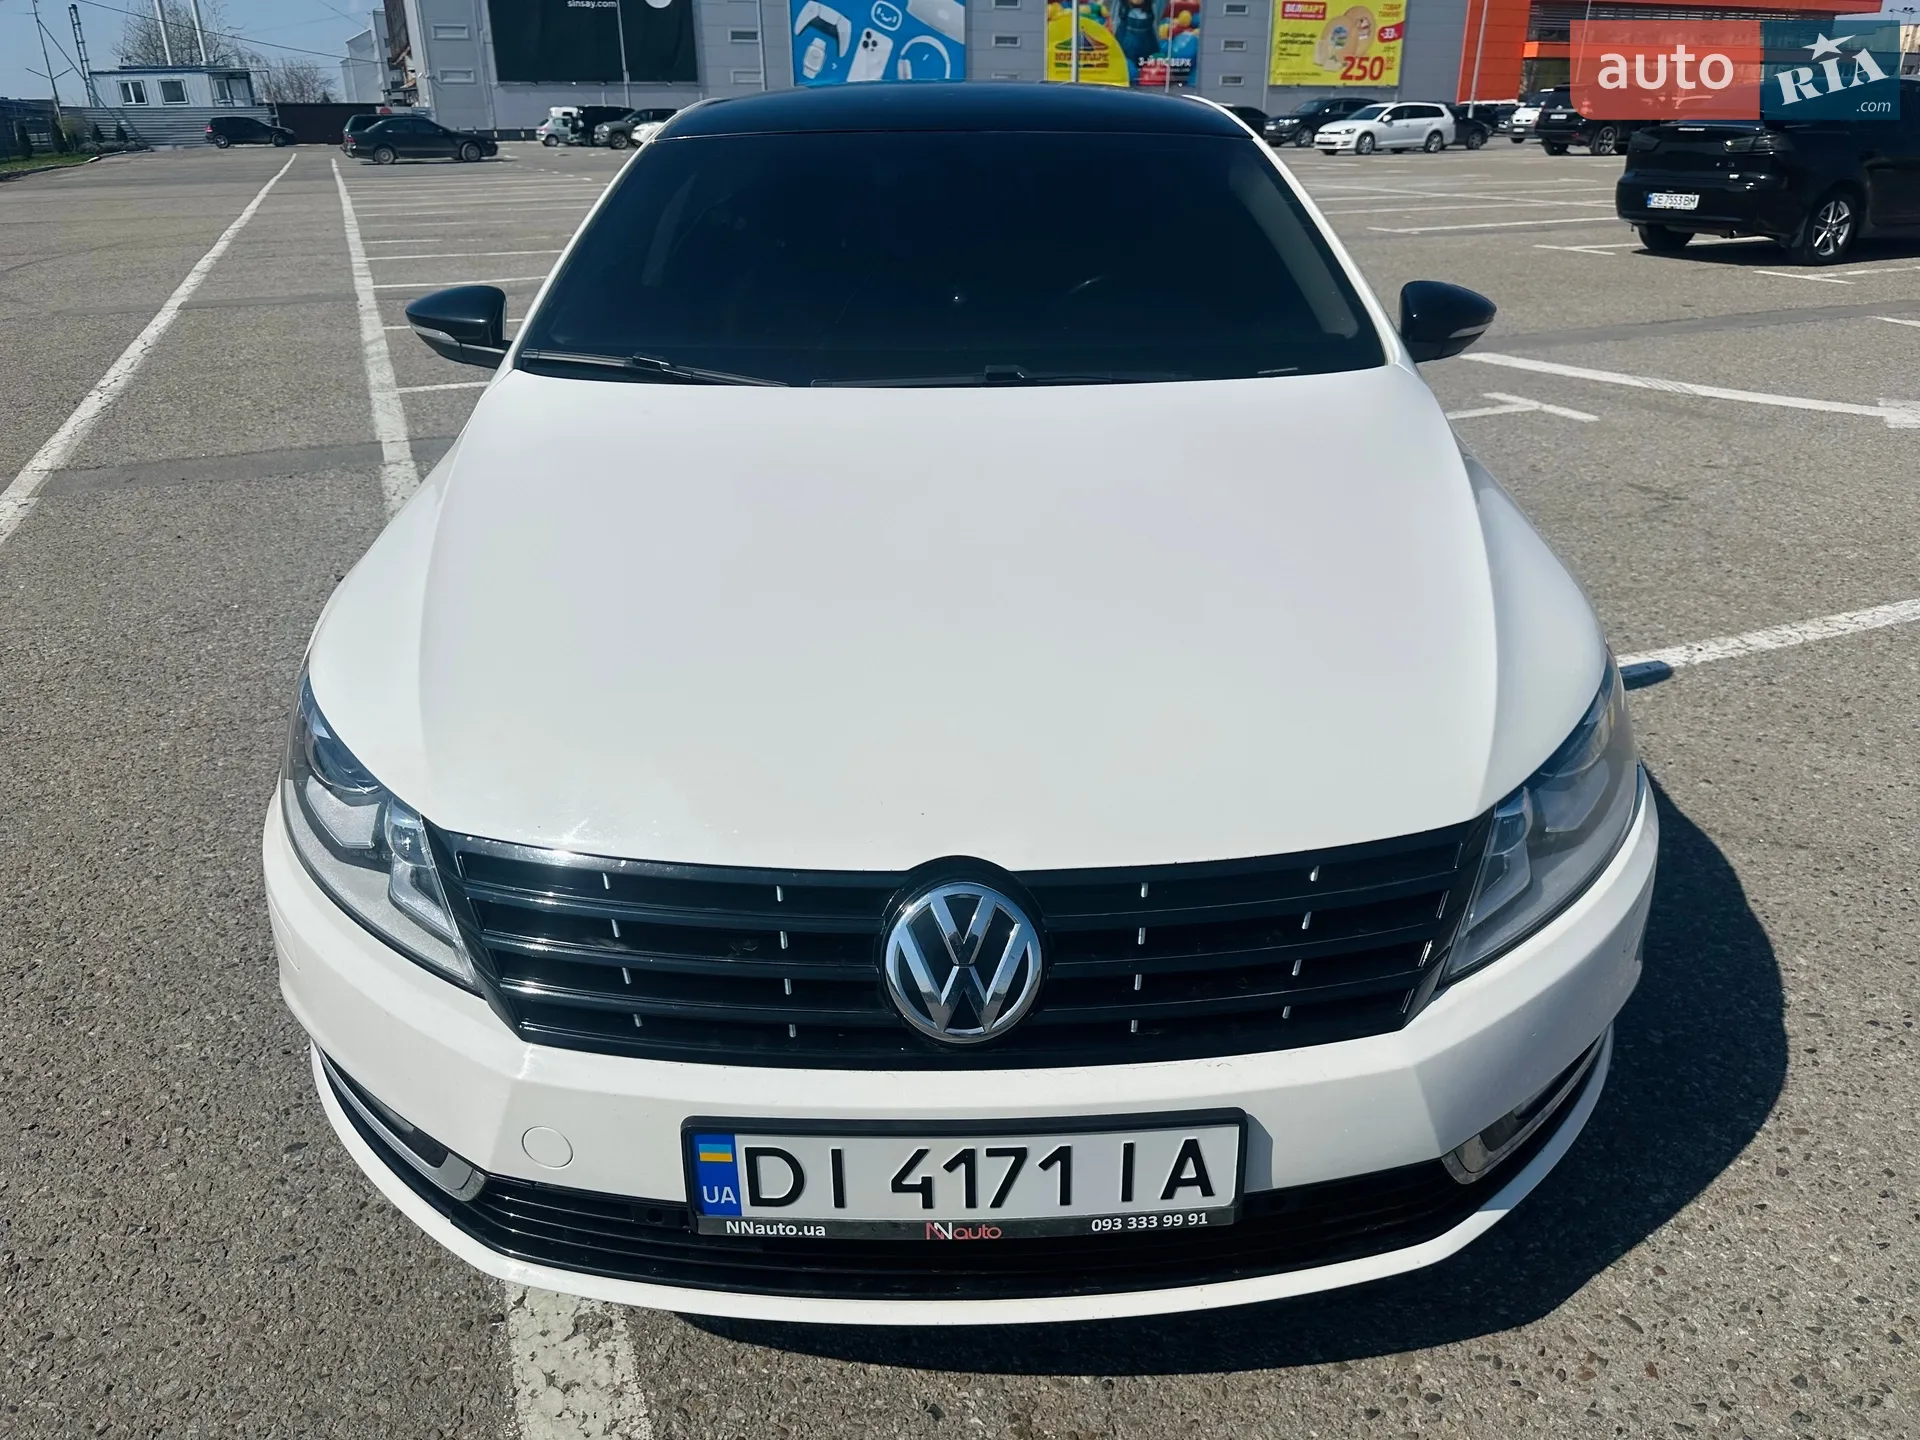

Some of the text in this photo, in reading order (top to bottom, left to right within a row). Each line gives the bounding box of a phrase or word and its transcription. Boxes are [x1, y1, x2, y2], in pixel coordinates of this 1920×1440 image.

[567, 0, 617, 9] sinsay.com
[1340, 55, 1384, 81] 250
[744, 1138, 1216, 1209] DI 4171 IA
[703, 1185, 737, 1205] UA
[726, 1220, 826, 1236] NNauto.ua
[1091, 1212, 1208, 1232] 093 333 99 91
